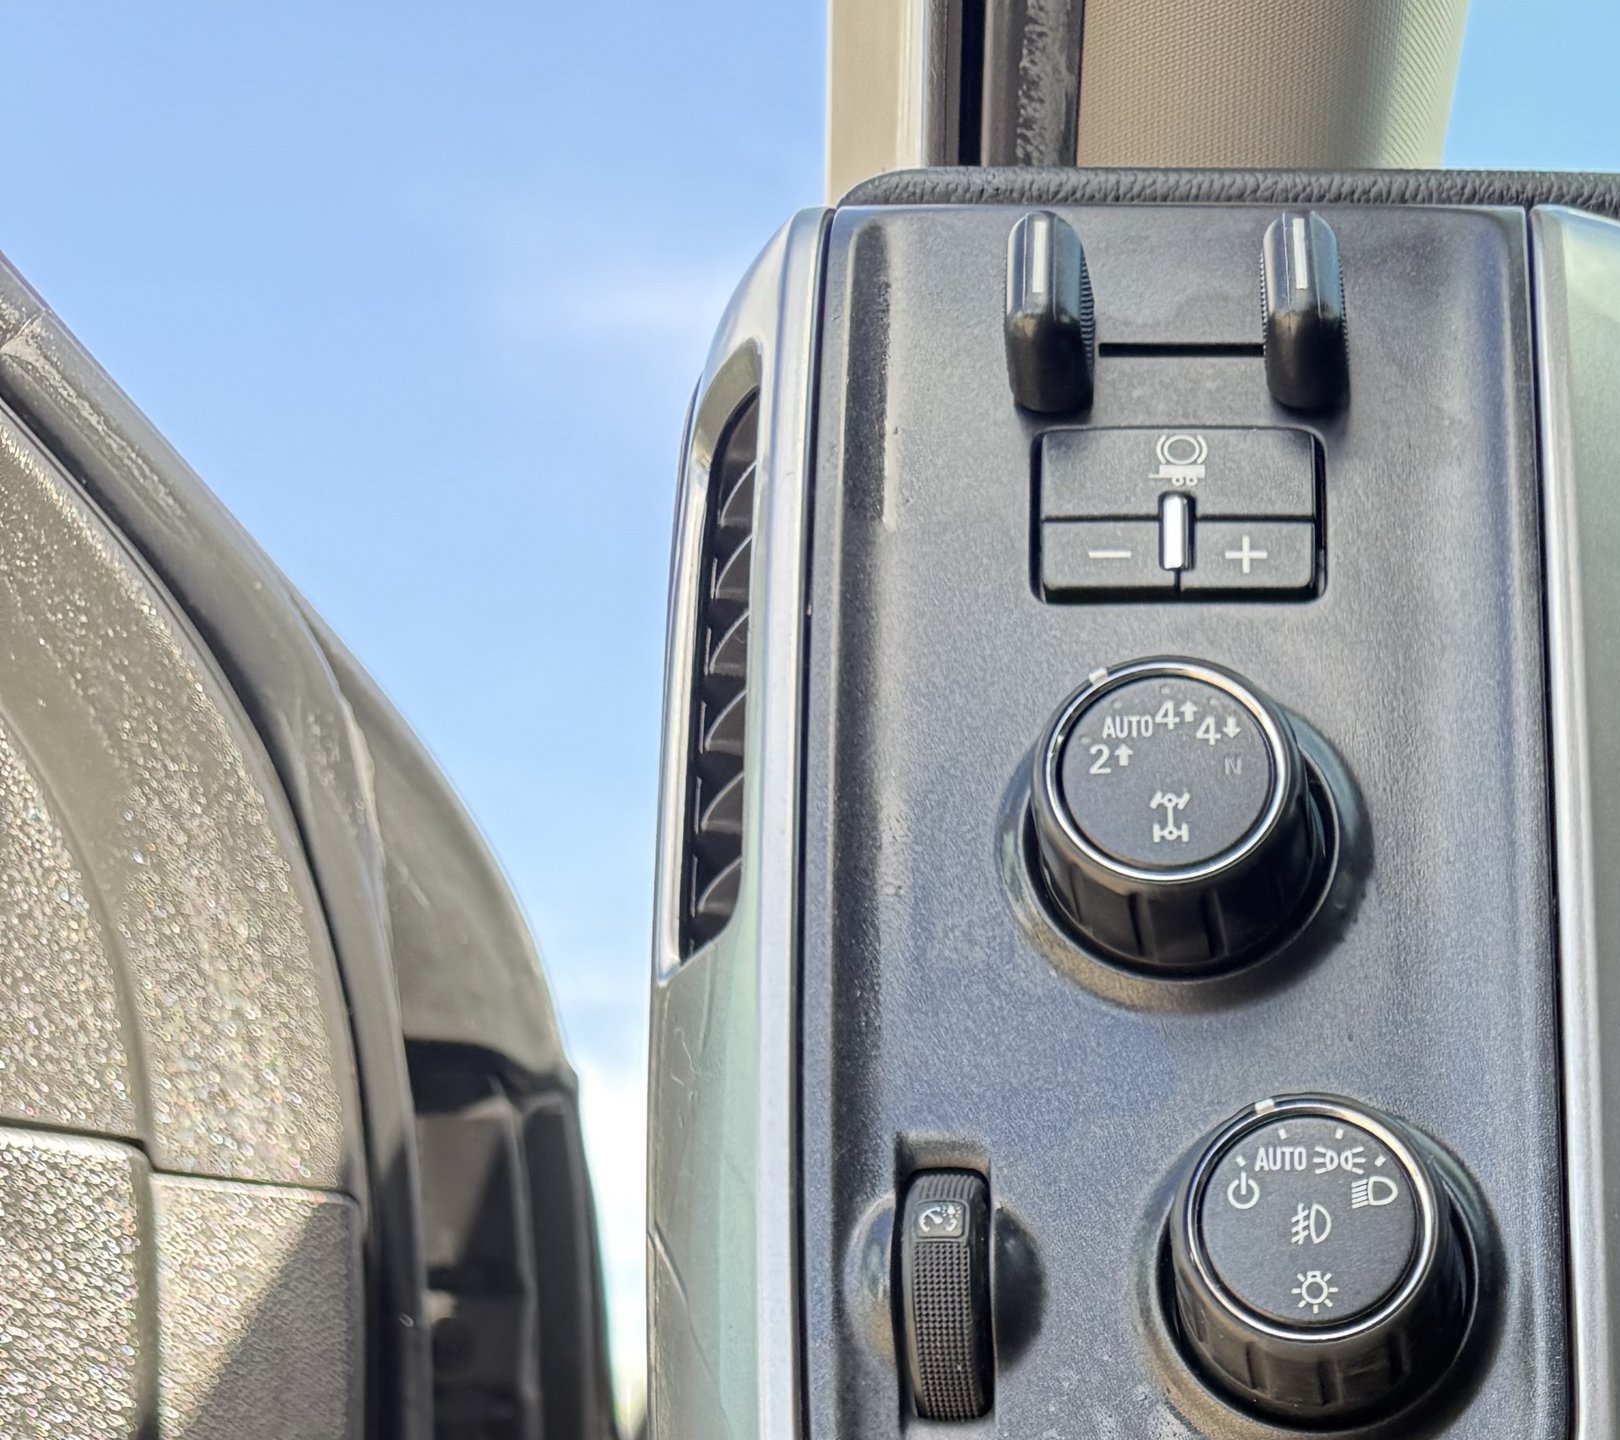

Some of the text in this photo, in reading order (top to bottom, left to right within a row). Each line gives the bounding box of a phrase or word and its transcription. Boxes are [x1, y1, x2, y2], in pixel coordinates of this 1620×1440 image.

[1089, 700, 1219, 774] 2 AUTO 4 4
[1224, 756, 1242, 775] N
[1254, 1146, 1307, 1171] AUTO
